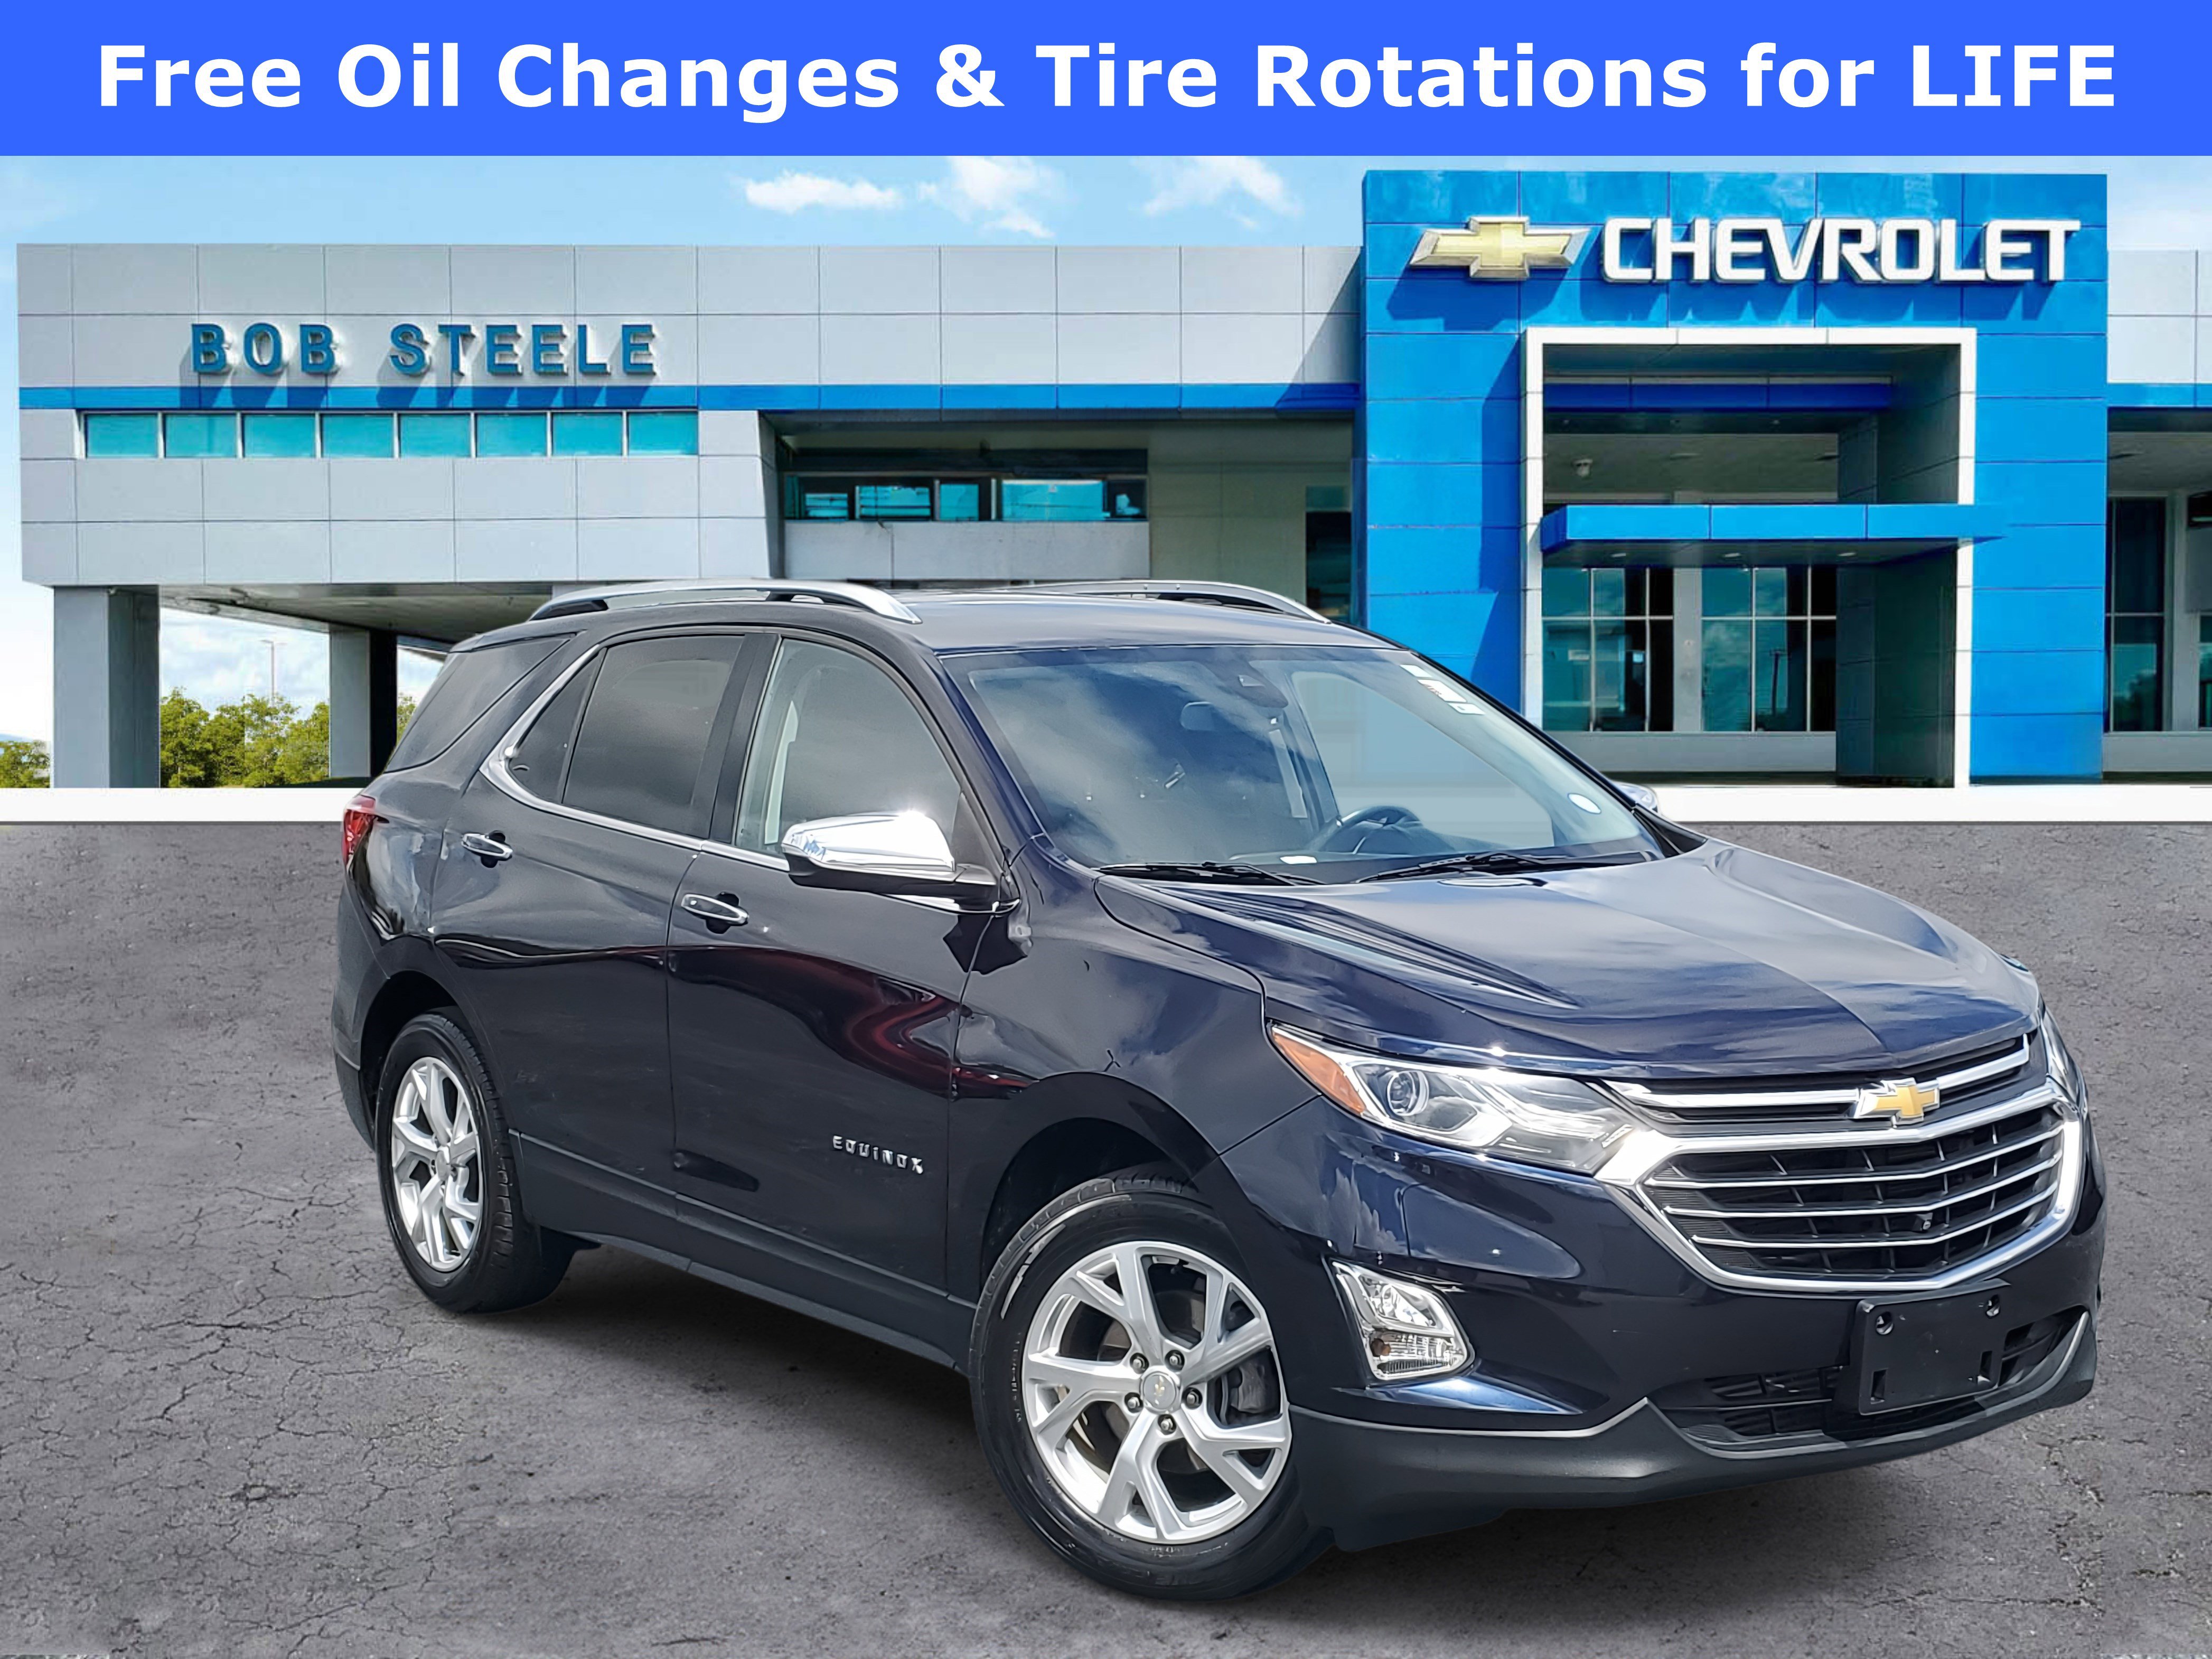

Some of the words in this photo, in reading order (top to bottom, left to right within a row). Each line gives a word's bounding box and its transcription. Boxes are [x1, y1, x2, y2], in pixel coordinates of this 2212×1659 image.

[1602, 217, 2082, 283] CHEVROLET
[191, 323, 340, 375] BOB
[389, 323, 658, 376] STEELE
[832, 1135, 924, 1174] EQUINOX
